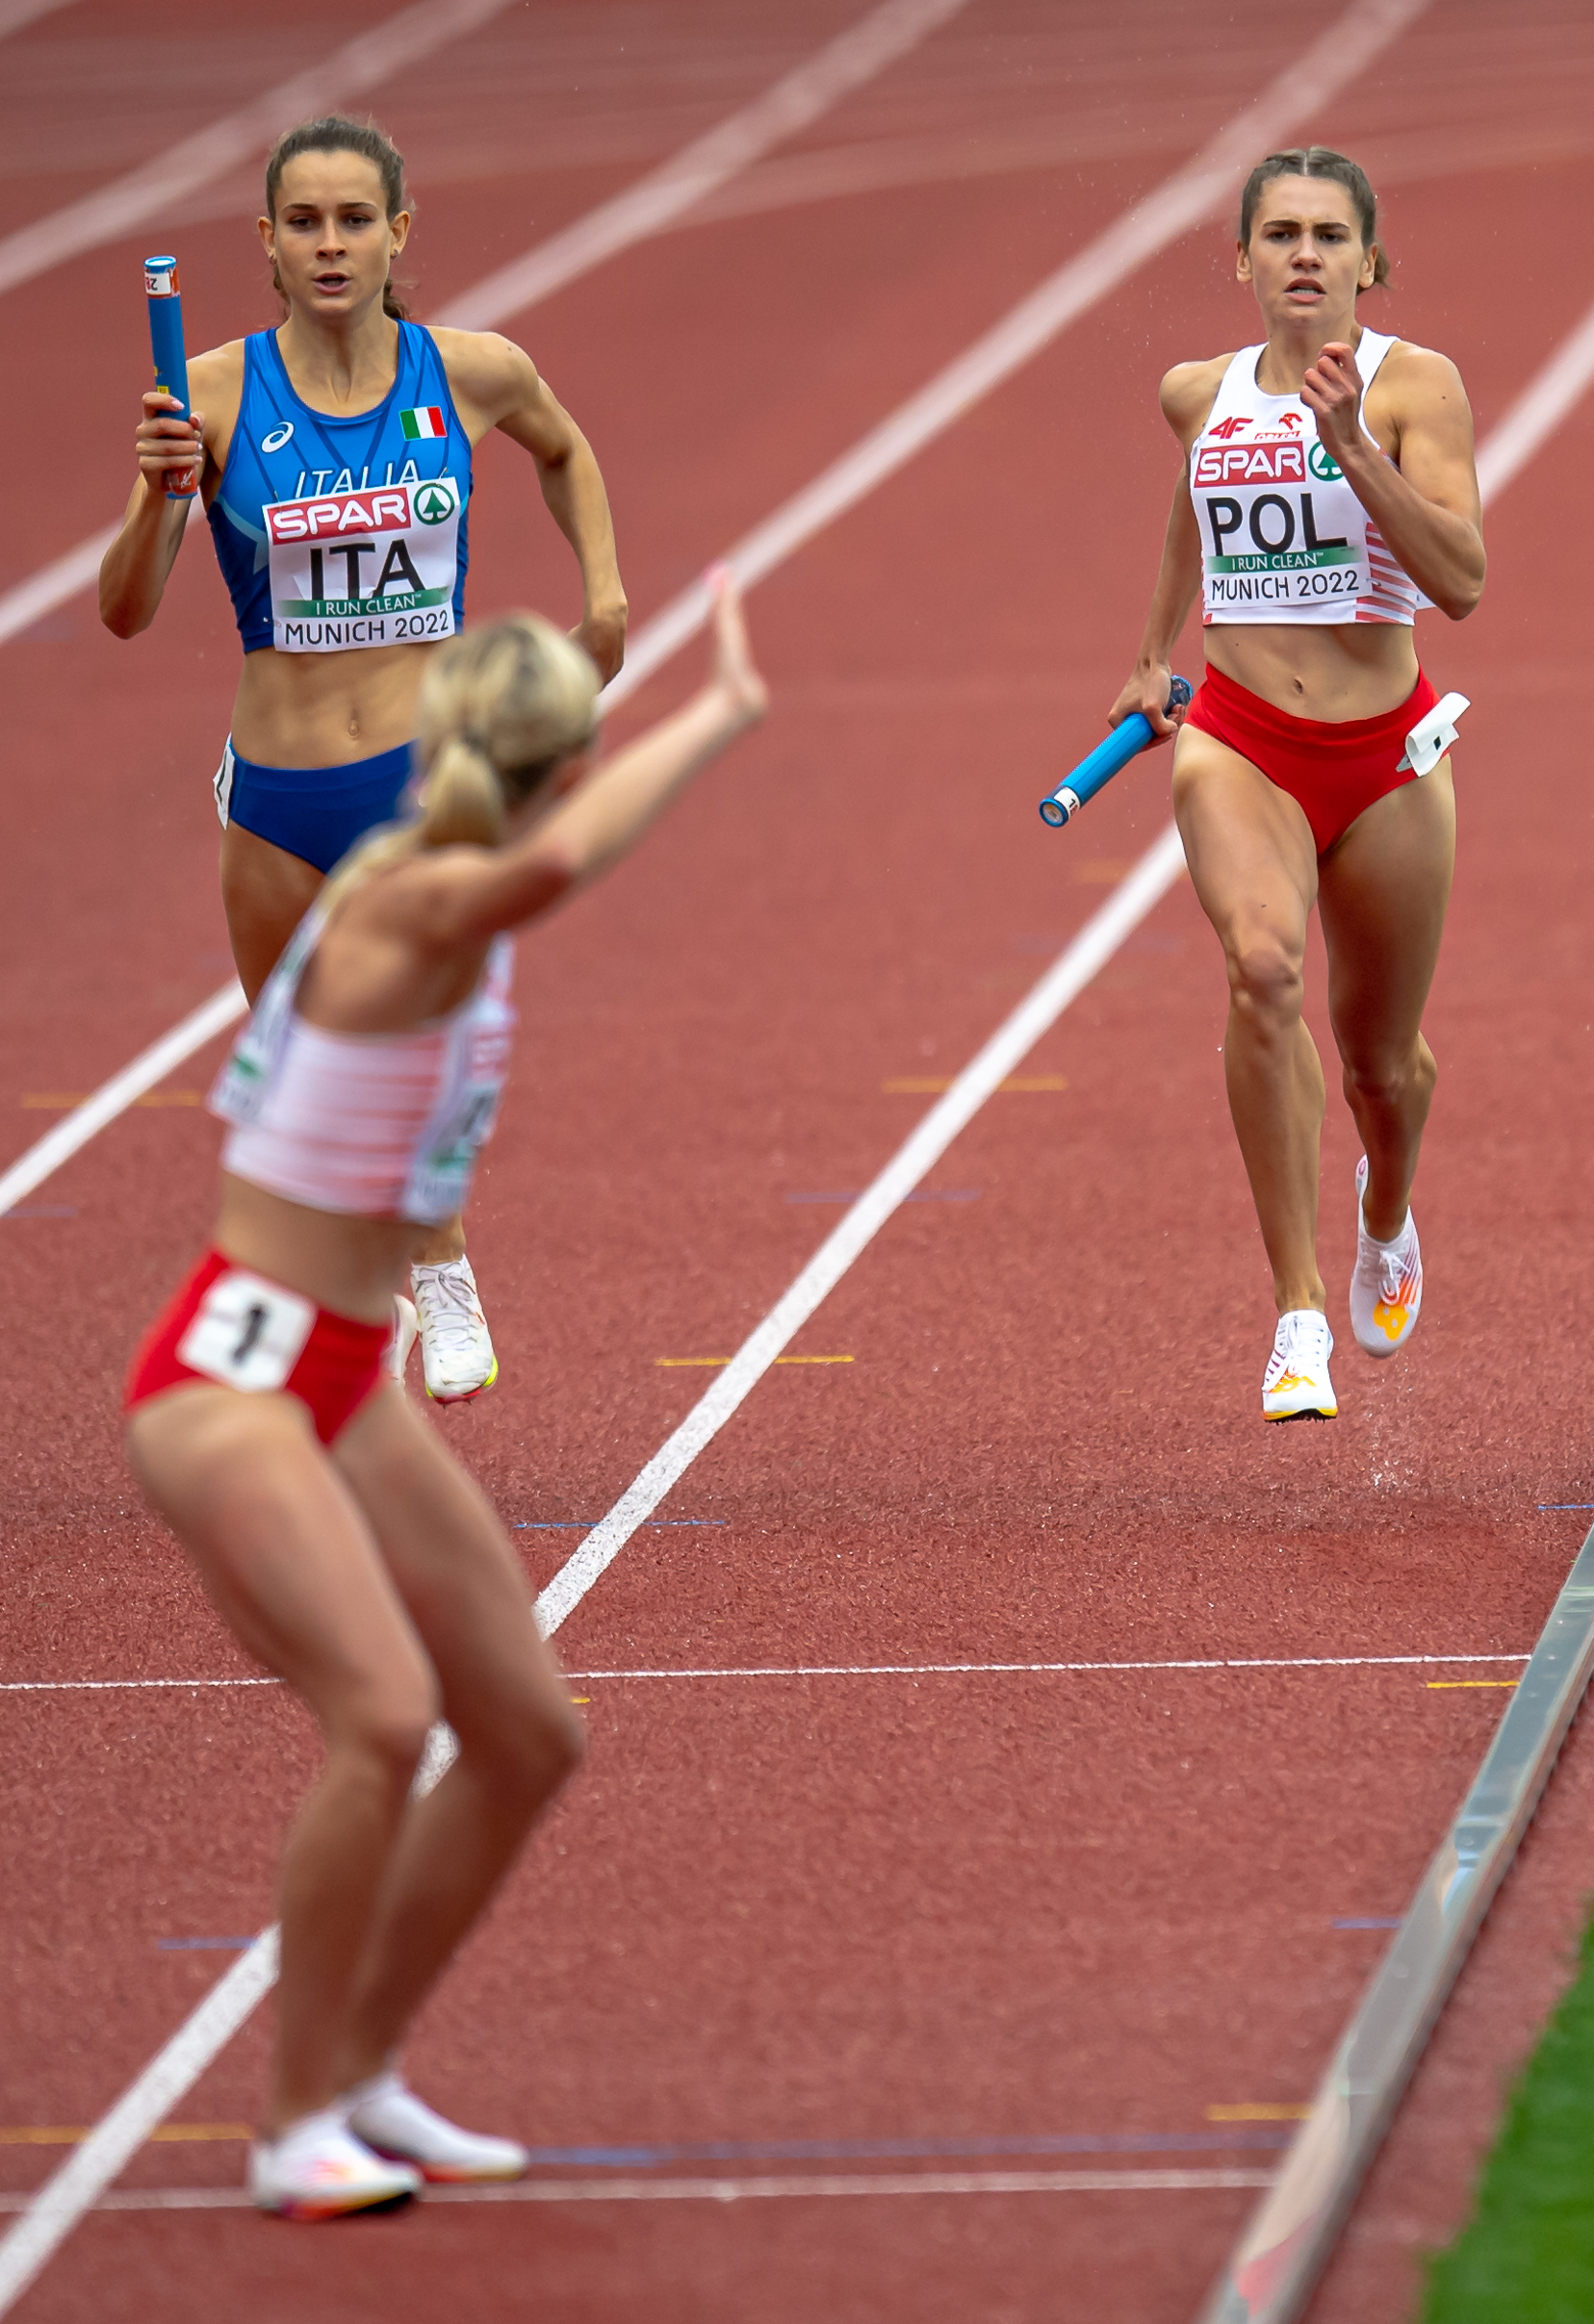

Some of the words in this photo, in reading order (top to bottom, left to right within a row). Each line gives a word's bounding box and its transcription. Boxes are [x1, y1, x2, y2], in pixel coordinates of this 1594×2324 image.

[1208, 416, 1254, 440] 4F
[295, 459, 420, 498] ITALIA
[1197, 447, 1303, 482] SPAR
[272, 494, 408, 540] SPAR
[1206, 492, 1348, 556] POL
[310, 539, 426, 600] ITA
[1232, 557, 1236, 571] I
[1238, 556, 1269, 571] RUN
[1212, 575, 1290, 601] MUNICH
[1297, 570, 1359, 597] 2022
[316, 601, 321, 616] I
[325, 600, 361, 616] RUN
[285, 619, 385, 646] MUNICH
[395, 610, 449, 639] 2022
[229, 1300, 269, 1370] 1
